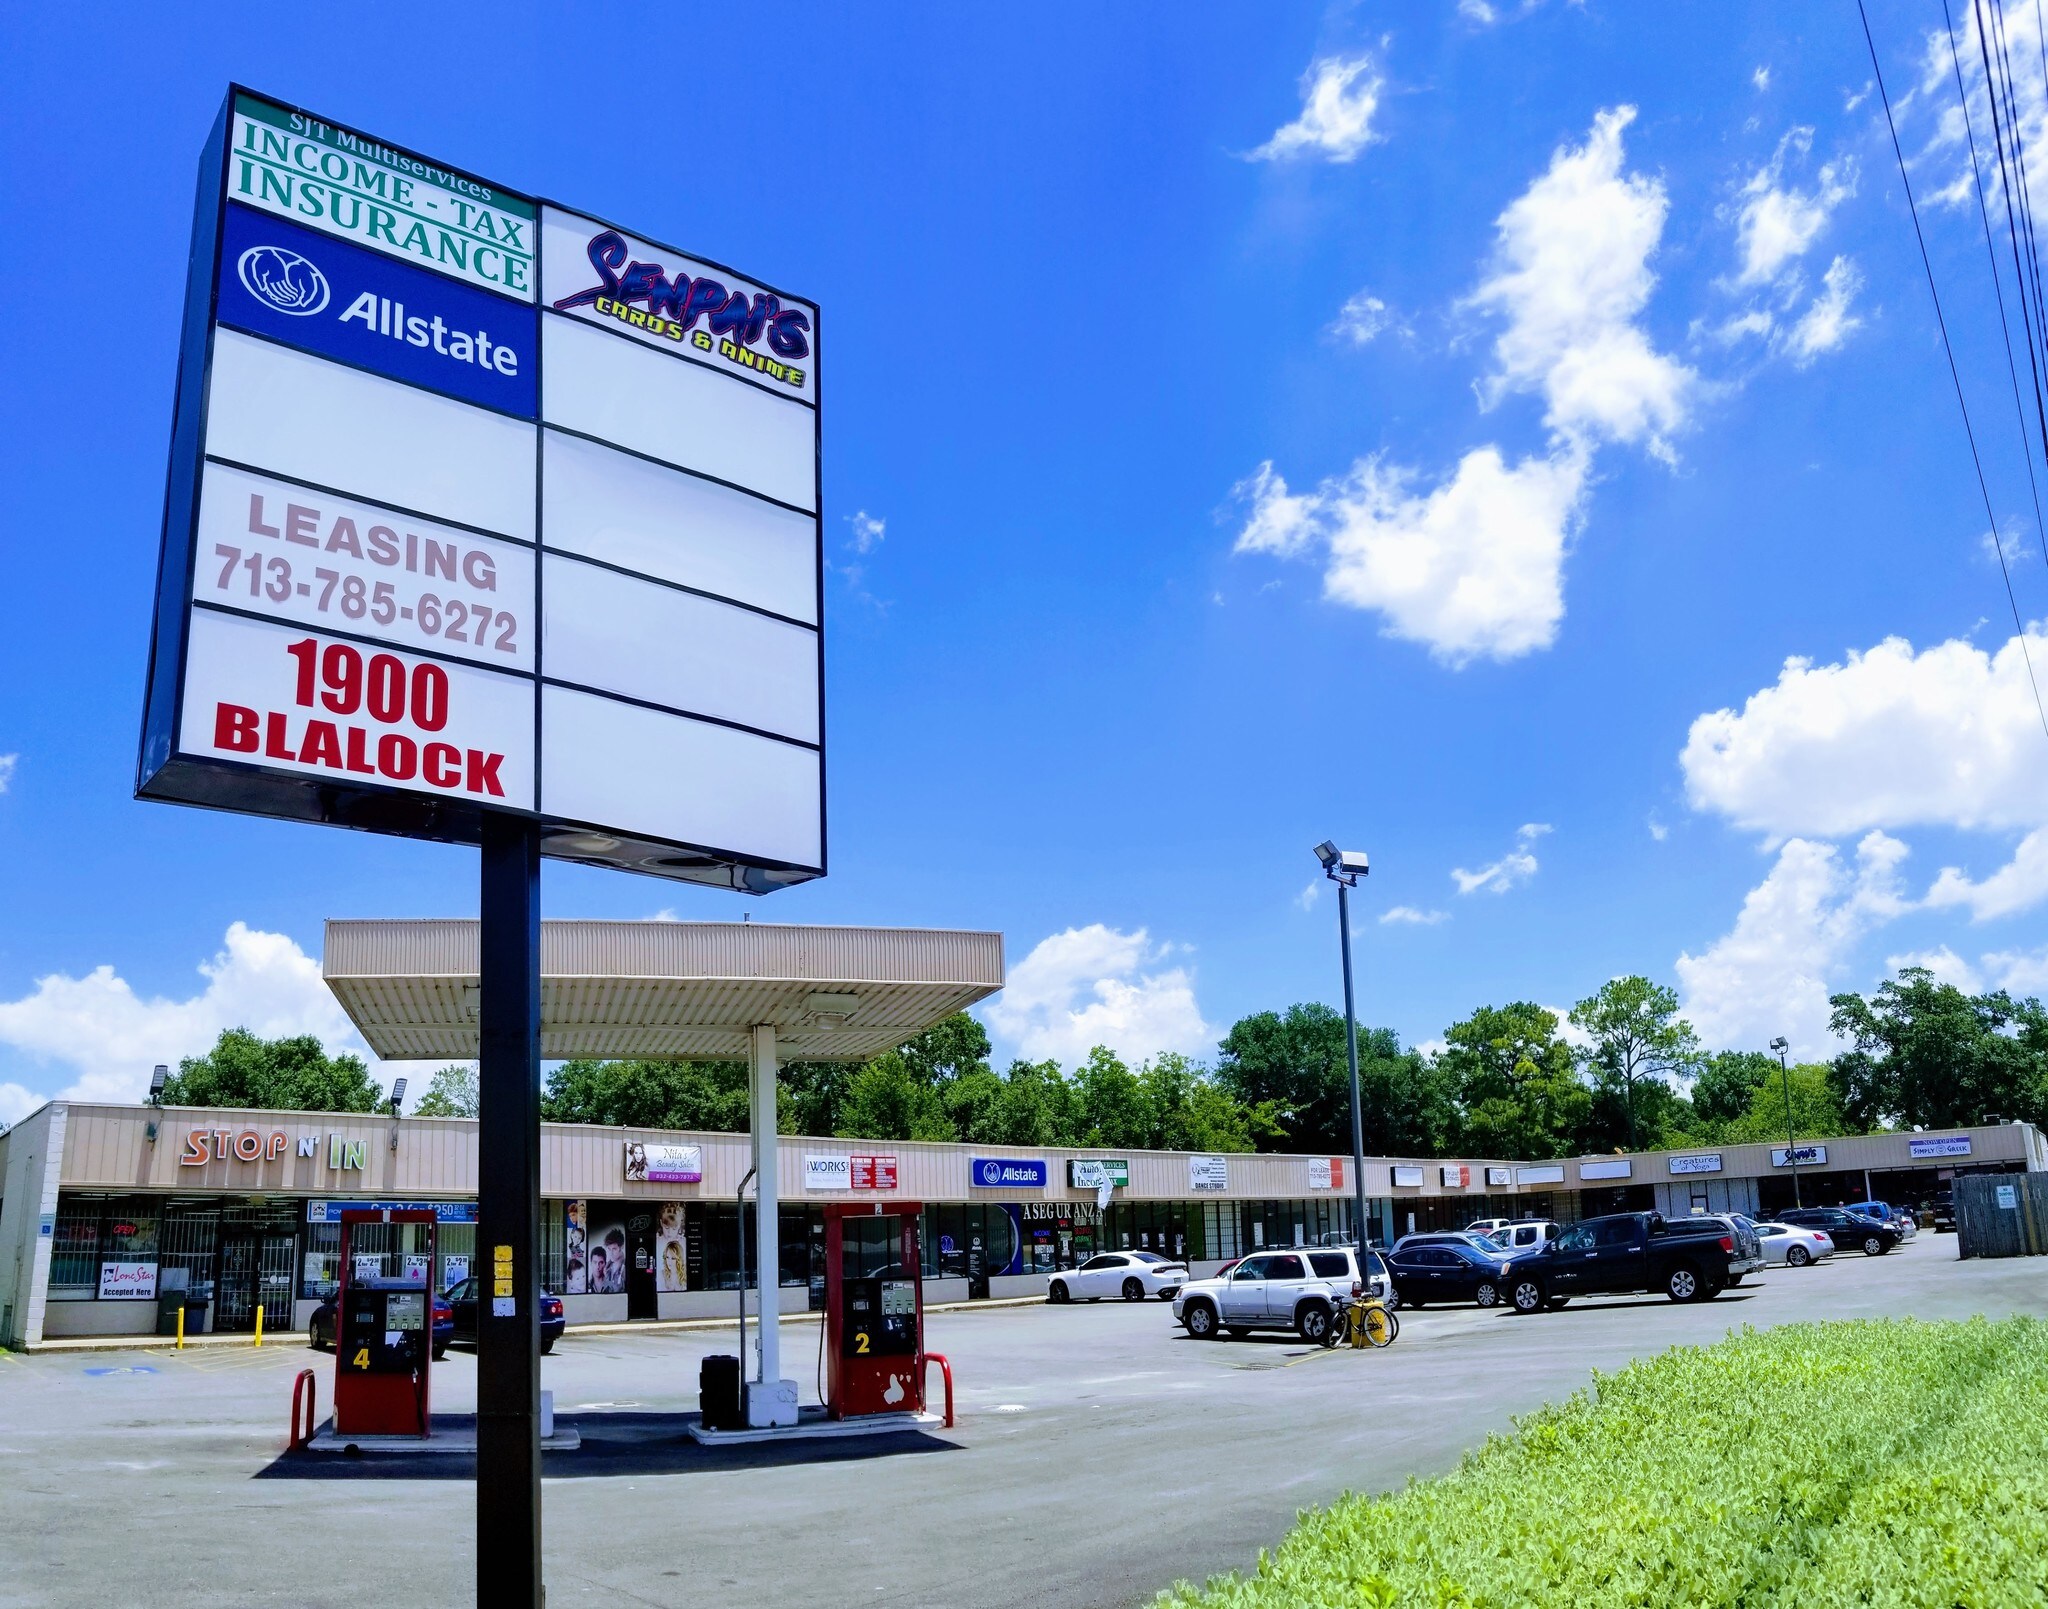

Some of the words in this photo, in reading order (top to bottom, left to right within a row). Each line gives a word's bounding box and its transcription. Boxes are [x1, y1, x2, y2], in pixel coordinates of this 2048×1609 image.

[290, 111, 334, 140] SJT
[336, 128, 492, 202] Multiservices
[243, 121, 415, 209] INCOME
[450, 198, 525, 250] TAX
[237, 158, 529, 294] INSURANCE
[338, 291, 519, 377] Allstate
[593, 296, 684, 342] CARDS
[691, 329, 713, 353] &
[718, 340, 806, 388] ANIME
[248, 493, 498, 592] LEASING
[215, 543, 517, 654] 713-785-6272
[287, 637, 449, 732] 1900
[213, 701, 506, 798] BLALOCK
[180, 1127, 289, 1166] STOP
[329, 1131, 368, 1170] IN
[1671, 1156, 1720, 1167] Creatures
[1913, 1147, 1935, 1155] SIMPLY
[1946, 1145, 1968, 1153] GREEK
[656, 1159, 677, 1173] Beauty
[1001, 1166, 1038, 1181] Allstate
[1692, 1163, 1710, 1172] Yoga
[113, 1225, 136, 1235] OPEN
[113, 1265, 135, 1282] Lone
[134, 1266, 155, 1283] Star
[103, 1288, 134, 1296] Accepted
[136, 1288, 151, 1296] Here
[353, 1348, 371, 1370] 4
[855, 1332, 870, 1354] 2
